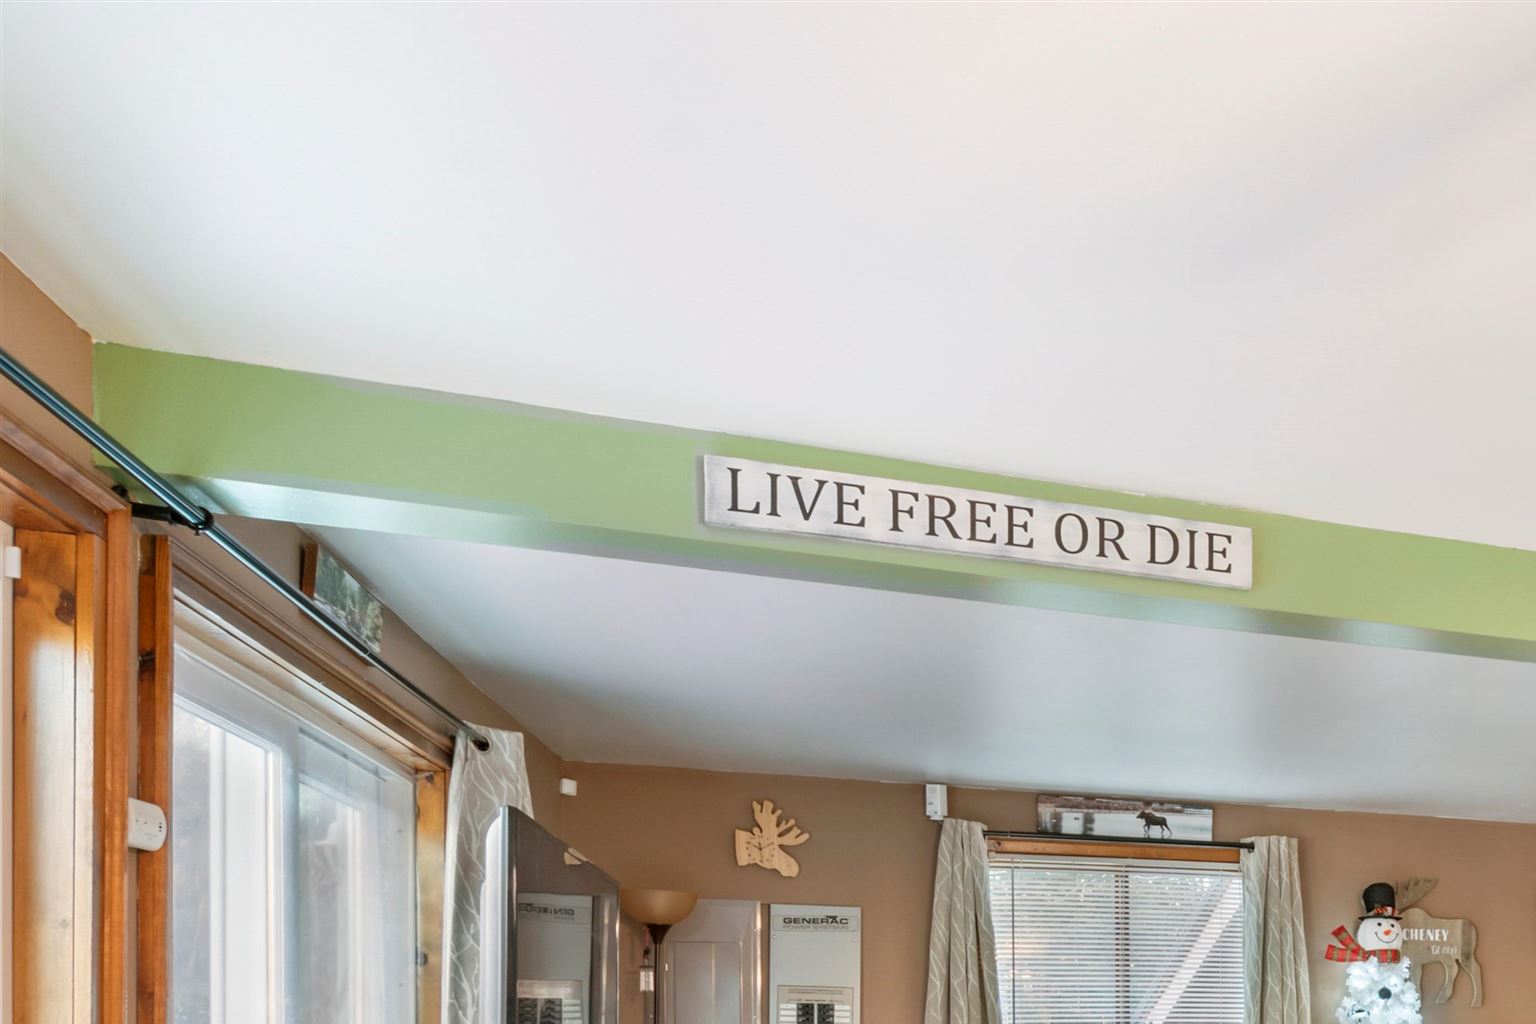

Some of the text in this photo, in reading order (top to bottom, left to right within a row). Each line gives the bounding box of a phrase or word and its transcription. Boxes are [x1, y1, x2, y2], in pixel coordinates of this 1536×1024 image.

[726, 466, 1233, 574] LIVE FREE OR DIE
[783, 915, 849, 925] GENERAC
[1403, 928, 1449, 941] CHENEY
